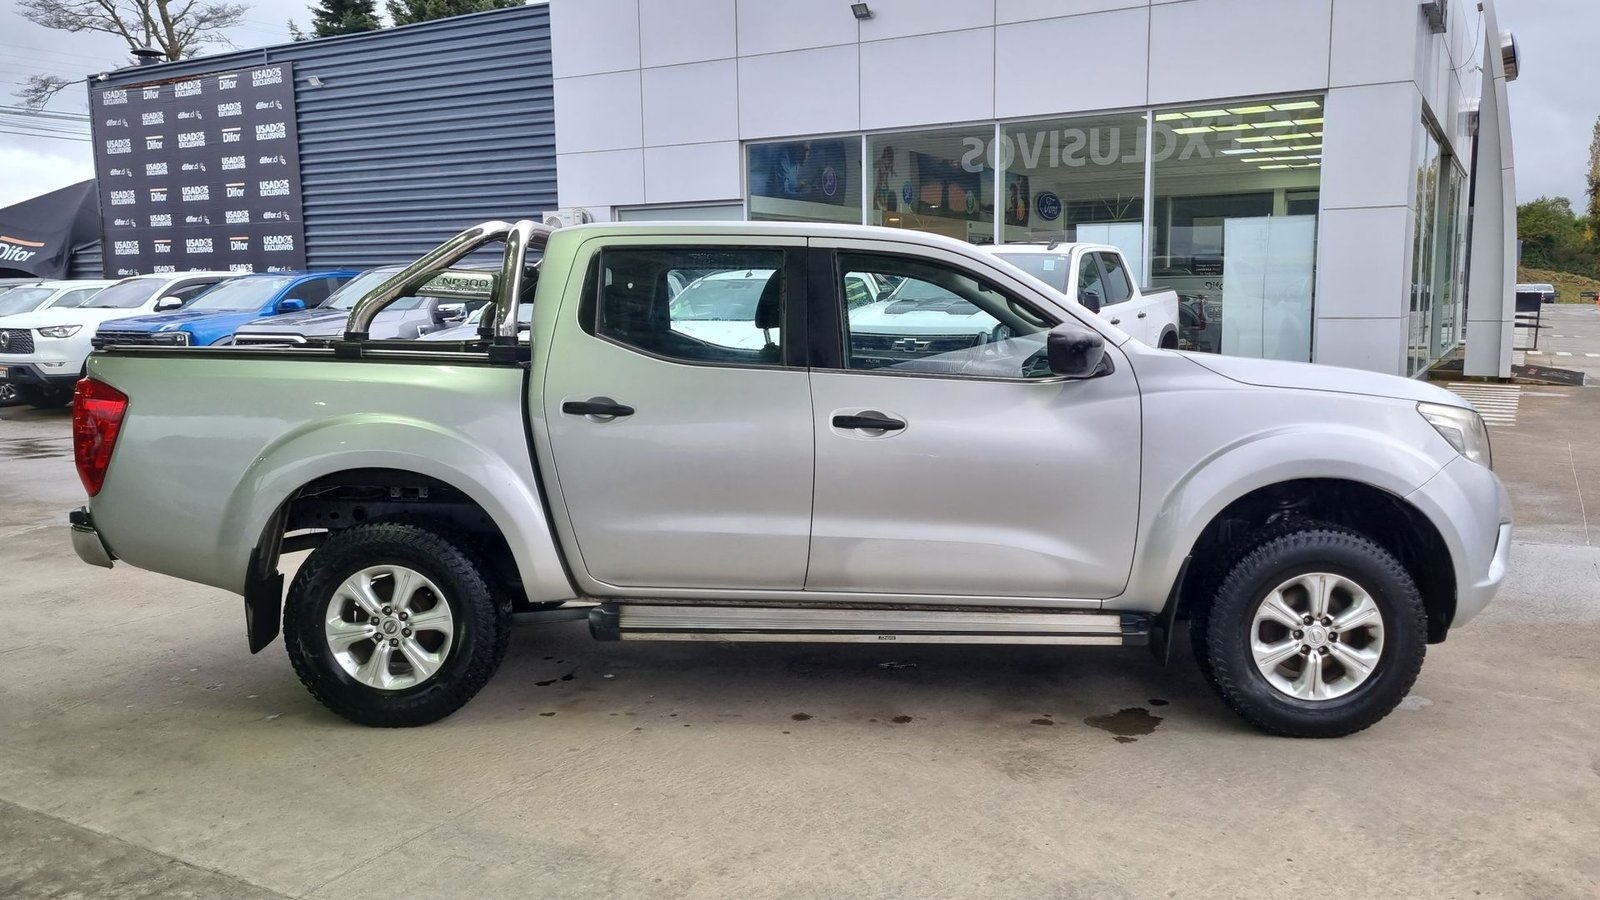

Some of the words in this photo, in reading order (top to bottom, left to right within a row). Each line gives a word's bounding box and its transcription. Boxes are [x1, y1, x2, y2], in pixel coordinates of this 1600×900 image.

[252, 67, 281, 80] USADOS
[175, 80, 201, 90] USADOS
[220, 79, 237, 90] Difor
[253, 77, 282, 87] EXCLUSIVOS
[103, 90, 127, 99] USADOS
[143, 90, 159, 100] Difor
[175, 89, 202, 97] EXCLUSIVOS
[218, 102, 241, 111] USADOS
[142, 112, 163, 120] USADOS
[219, 109, 242, 117] EXCLUSIVOS
[256, 123, 285, 134] USADOS
[178, 132, 204, 142] USADOS
[223, 131, 240, 143] Difor
[256, 131, 286, 140] EXCLUSIVOS
[107, 139, 131, 148] USADOS
[147, 139, 163, 149] Difor
[179, 139, 205, 148] EXCLUSIVOS
[107, 146, 131, 154] EXCLUSIVOS
[222, 156, 245, 165] USADOS
[146, 168, 168, 176] EXCLUSIVOS
[260, 180, 289, 190] USADOS
[111, 190, 135, 199] USADOS
[182, 186, 208, 195] USADOS
[227, 186, 244, 197] Difor
[260, 187, 290, 196] EXCLUSIVOS
[151, 191, 167, 201] Difor
[183, 193, 209, 201] EXCLUSIVOS
[111, 197, 135, 205] EXCLUSIVOS
[150, 214, 171, 222] USADOS
[226, 210, 249, 218] USADOS
[226, 216, 249, 224] EXCLUSIVOS
[186, 239, 212, 248] USADOS
[263, 235, 293, 245] USADOS
[115, 241, 139, 249] USADOS
[155, 243, 171, 253] Difor
[187, 245, 213, 253] EXCLUSIVOS
[231, 240, 248, 251] Difor
[264, 243, 293, 252] EXCLUSIVOS
[0, 243, 36, 262] Difor
[115, 247, 139, 255] EXCLUSIVOS
[154, 265, 175, 273] USADOS
[230, 264, 253, 272] USADOS
[443, 277, 489, 288] NP300
